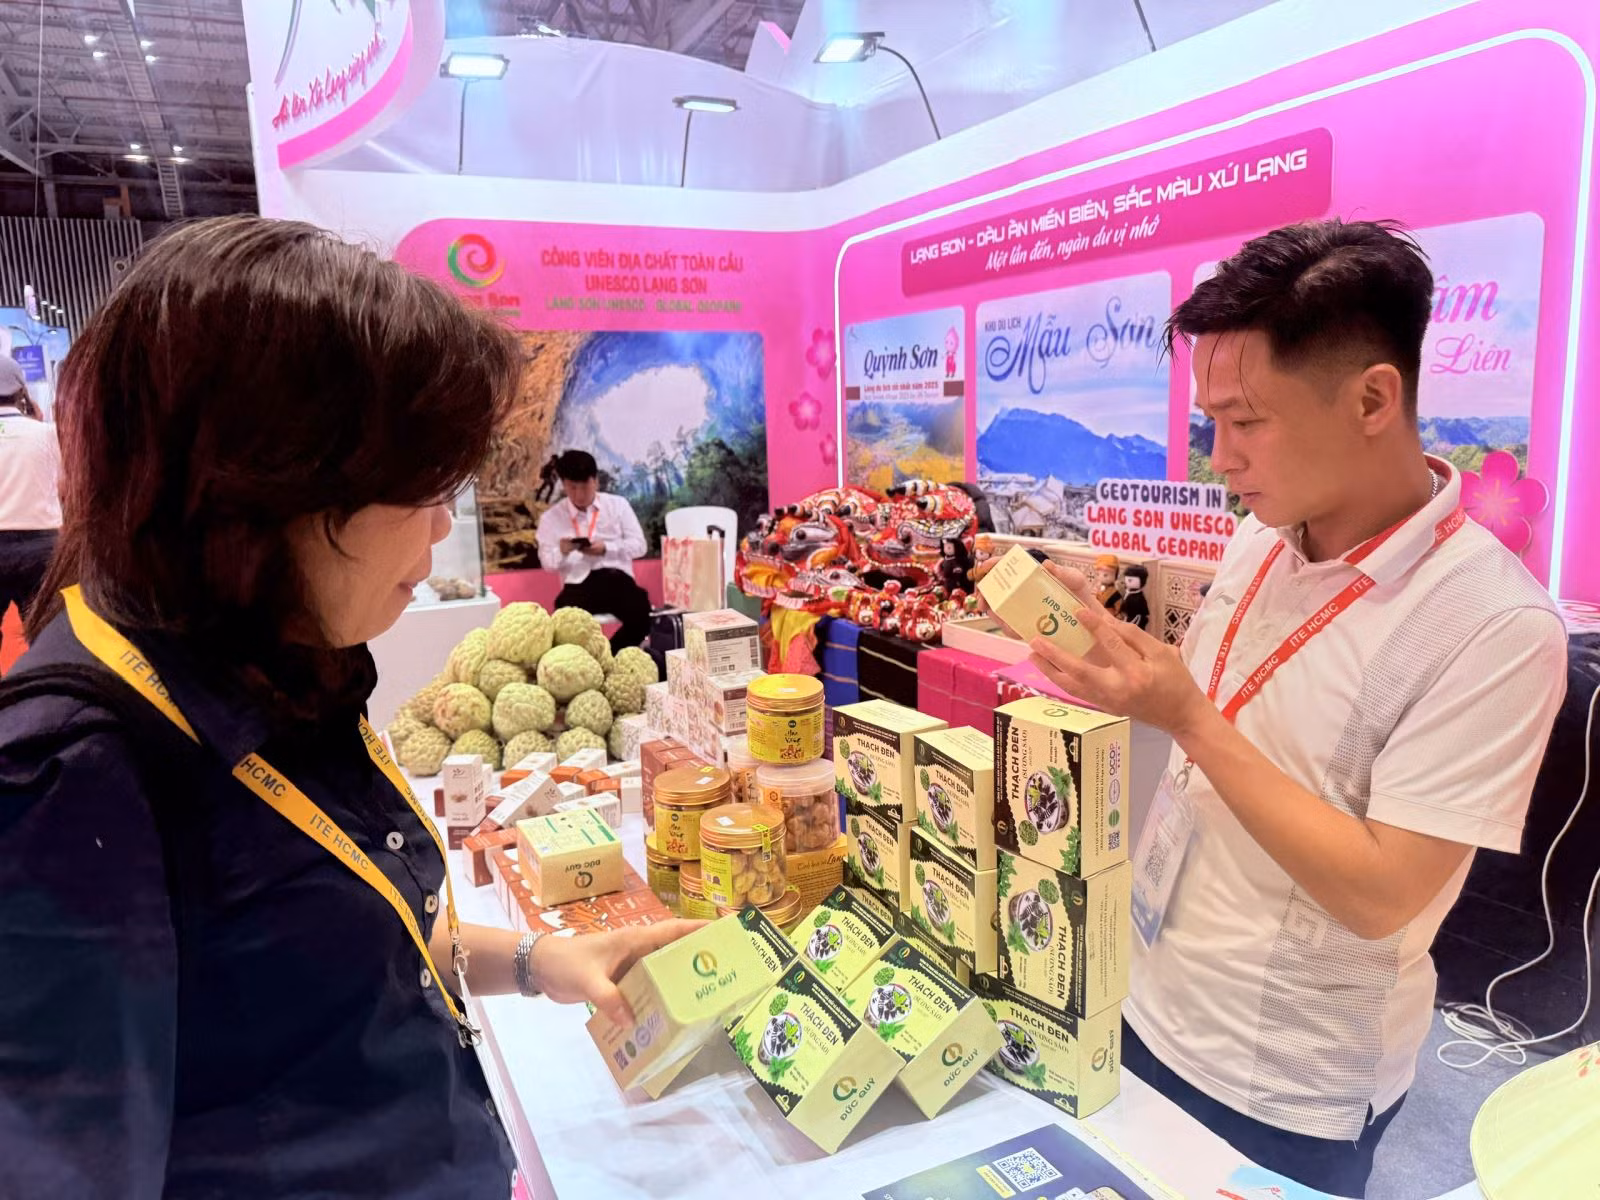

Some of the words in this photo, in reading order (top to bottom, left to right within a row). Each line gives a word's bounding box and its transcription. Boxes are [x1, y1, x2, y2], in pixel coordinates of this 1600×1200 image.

[910, 243, 940, 266] LẠNG
[1113, 184, 1152, 214] SẮC
[1156, 175, 1203, 204] MÀU
[1208, 161, 1239, 192] XỨ
[1244, 148, 1308, 183] LẠNG
[1057, 231, 1090, 260] ngàn
[1113, 222, 1129, 247] vị
[585, 274, 639, 293] UNESCO
[1432, 274, 1498, 323] âm
[864, 346, 908, 380] Quỳnh
[909, 344, 938, 370] Sơn
[985, 311, 1071, 395] Mẫu
[1429, 333, 1511, 375] Liên
[1100, 482, 1200, 506] GEOTOURISM
[1206, 488, 1222, 508] IN
[1087, 505, 1127, 525] LANG
[1133, 509, 1164, 529] SON
[1170, 511, 1234, 537] UNESCO
[1091, 529, 1151, 553] GLOBAL
[1289, 629, 1308, 648] ITE
[1306, 602, 1339, 633] HCMC
[120, 649, 149, 676] ITE
[1240, 680, 1256, 699] ITE
[1253, 655, 1280, 685] HCMC
[857, 737, 880, 753] THẠCH
[880, 745, 895, 760] ĐEN
[1011, 727, 1020, 753] ĐEN
[240, 757, 286, 797] HCMC
[935, 769, 956, 790] THẠCH
[956, 783, 969, 798] ĐEN
[1011, 756, 1021, 800] THẠCH
[309, 813, 334, 839] ITE
[332, 833, 369, 871] HCMC
[932, 867, 954, 890] THẠCH
[955, 883, 969, 901] ĐEN
[841, 916, 863, 939] THẠCH
[860, 935, 876, 949] ĐEN
[1057, 925, 1067, 971] THẠCH
[764, 955, 779, 973] ĐEN
[908, 975, 934, 1000] THẠCH
[933, 996, 952, 1013] ĐEN
[1057, 972, 1066, 1000] ĐEN
[800, 1002, 824, 1031] THẠCH
[822, 1026, 839, 1046] ĐEN
[1010, 1006, 1045, 1032] THẠCH
[1047, 1026, 1069, 1044] ĐEN
[943, 1068, 962, 1087] ĐỨC
[962, 1048, 979, 1068] QUÝ
[840, 1101, 859, 1121] ĐỨC
[858, 1077, 876, 1099] QUÝ
